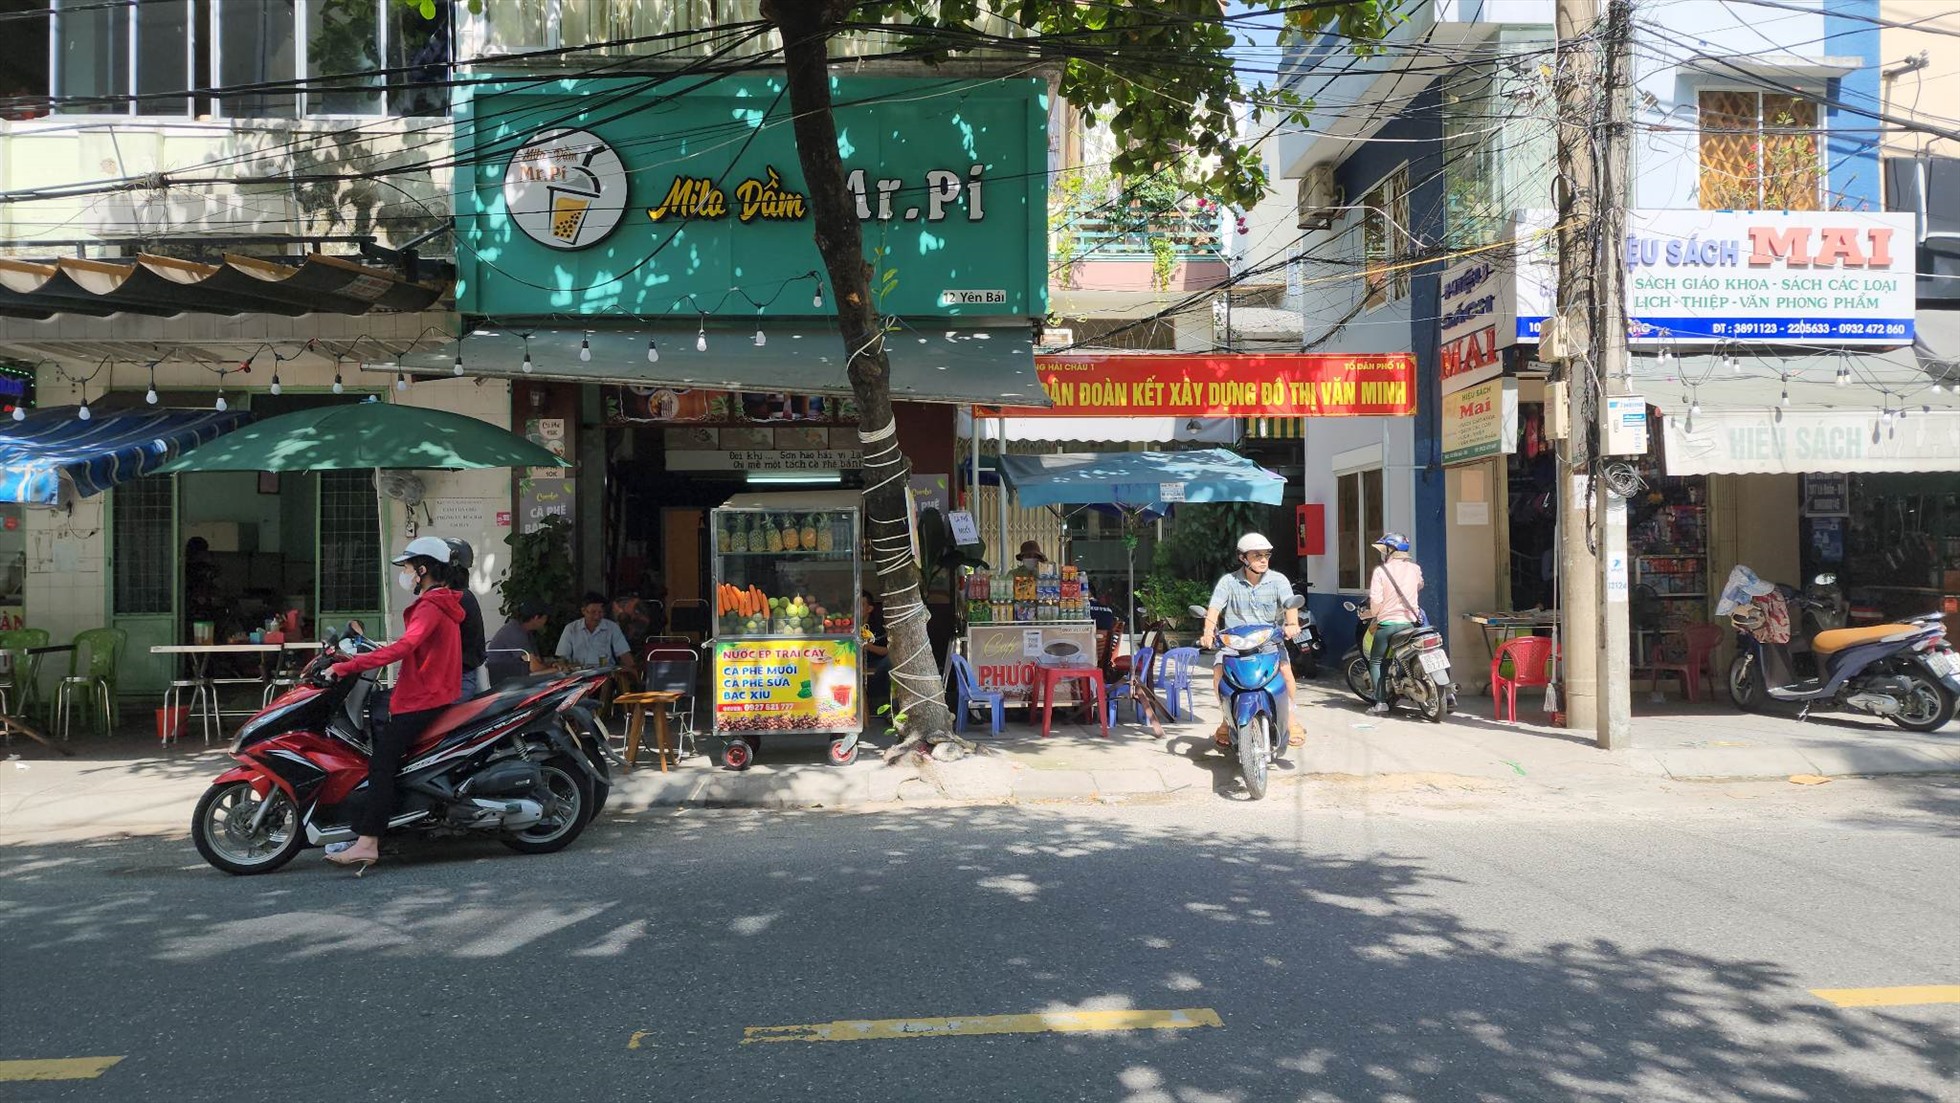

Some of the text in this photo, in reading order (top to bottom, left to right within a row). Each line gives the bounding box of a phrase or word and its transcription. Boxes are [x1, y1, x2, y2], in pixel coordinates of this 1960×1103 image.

[736, 165, 806, 221] Dầm
[1665, 233, 1739, 268] SÁCH
[1748, 227, 1894, 270] MAI
[960, 291, 982, 303] Yên
[986, 290, 1004, 303] Bái
[1634, 276, 1676, 290] SÁCH
[1682, 275, 1720, 290] GIÁO
[1725, 279, 1769, 290] KHOA
[1781, 275, 1823, 291] SÁCH
[1828, 275, 1859, 291] CÁC
[1864, 280, 1898, 294] LOẠI
[1634, 296, 1671, 310] LỊCH
[1681, 294, 1729, 310] THIỆP
[1739, 294, 1770, 308] VĂN
[1834, 292, 1879, 309] PHẨM
[1734, 323, 1777, 334] 3891123
[1787, 323, 1830, 334] 2205633
[1839, 324, 1864, 335] 0932
[1866, 324, 1885, 335] 472
[1886, 324, 1905, 335] 860
[1440, 327, 1499, 380] MAI
[1079, 377, 1128, 407] ĐOÀN
[1132, 374, 1164, 407] KẾT
[1169, 377, 1204, 406] XÂY
[1208, 380, 1257, 411] DỰNG
[1261, 377, 1285, 406] ĐÔ
[1289, 381, 1317, 411] THỊ
[1321, 376, 1356, 406] VĂN
[1361, 381, 1407, 405] MINH
[1795, 419, 1864, 460] SÁCH
